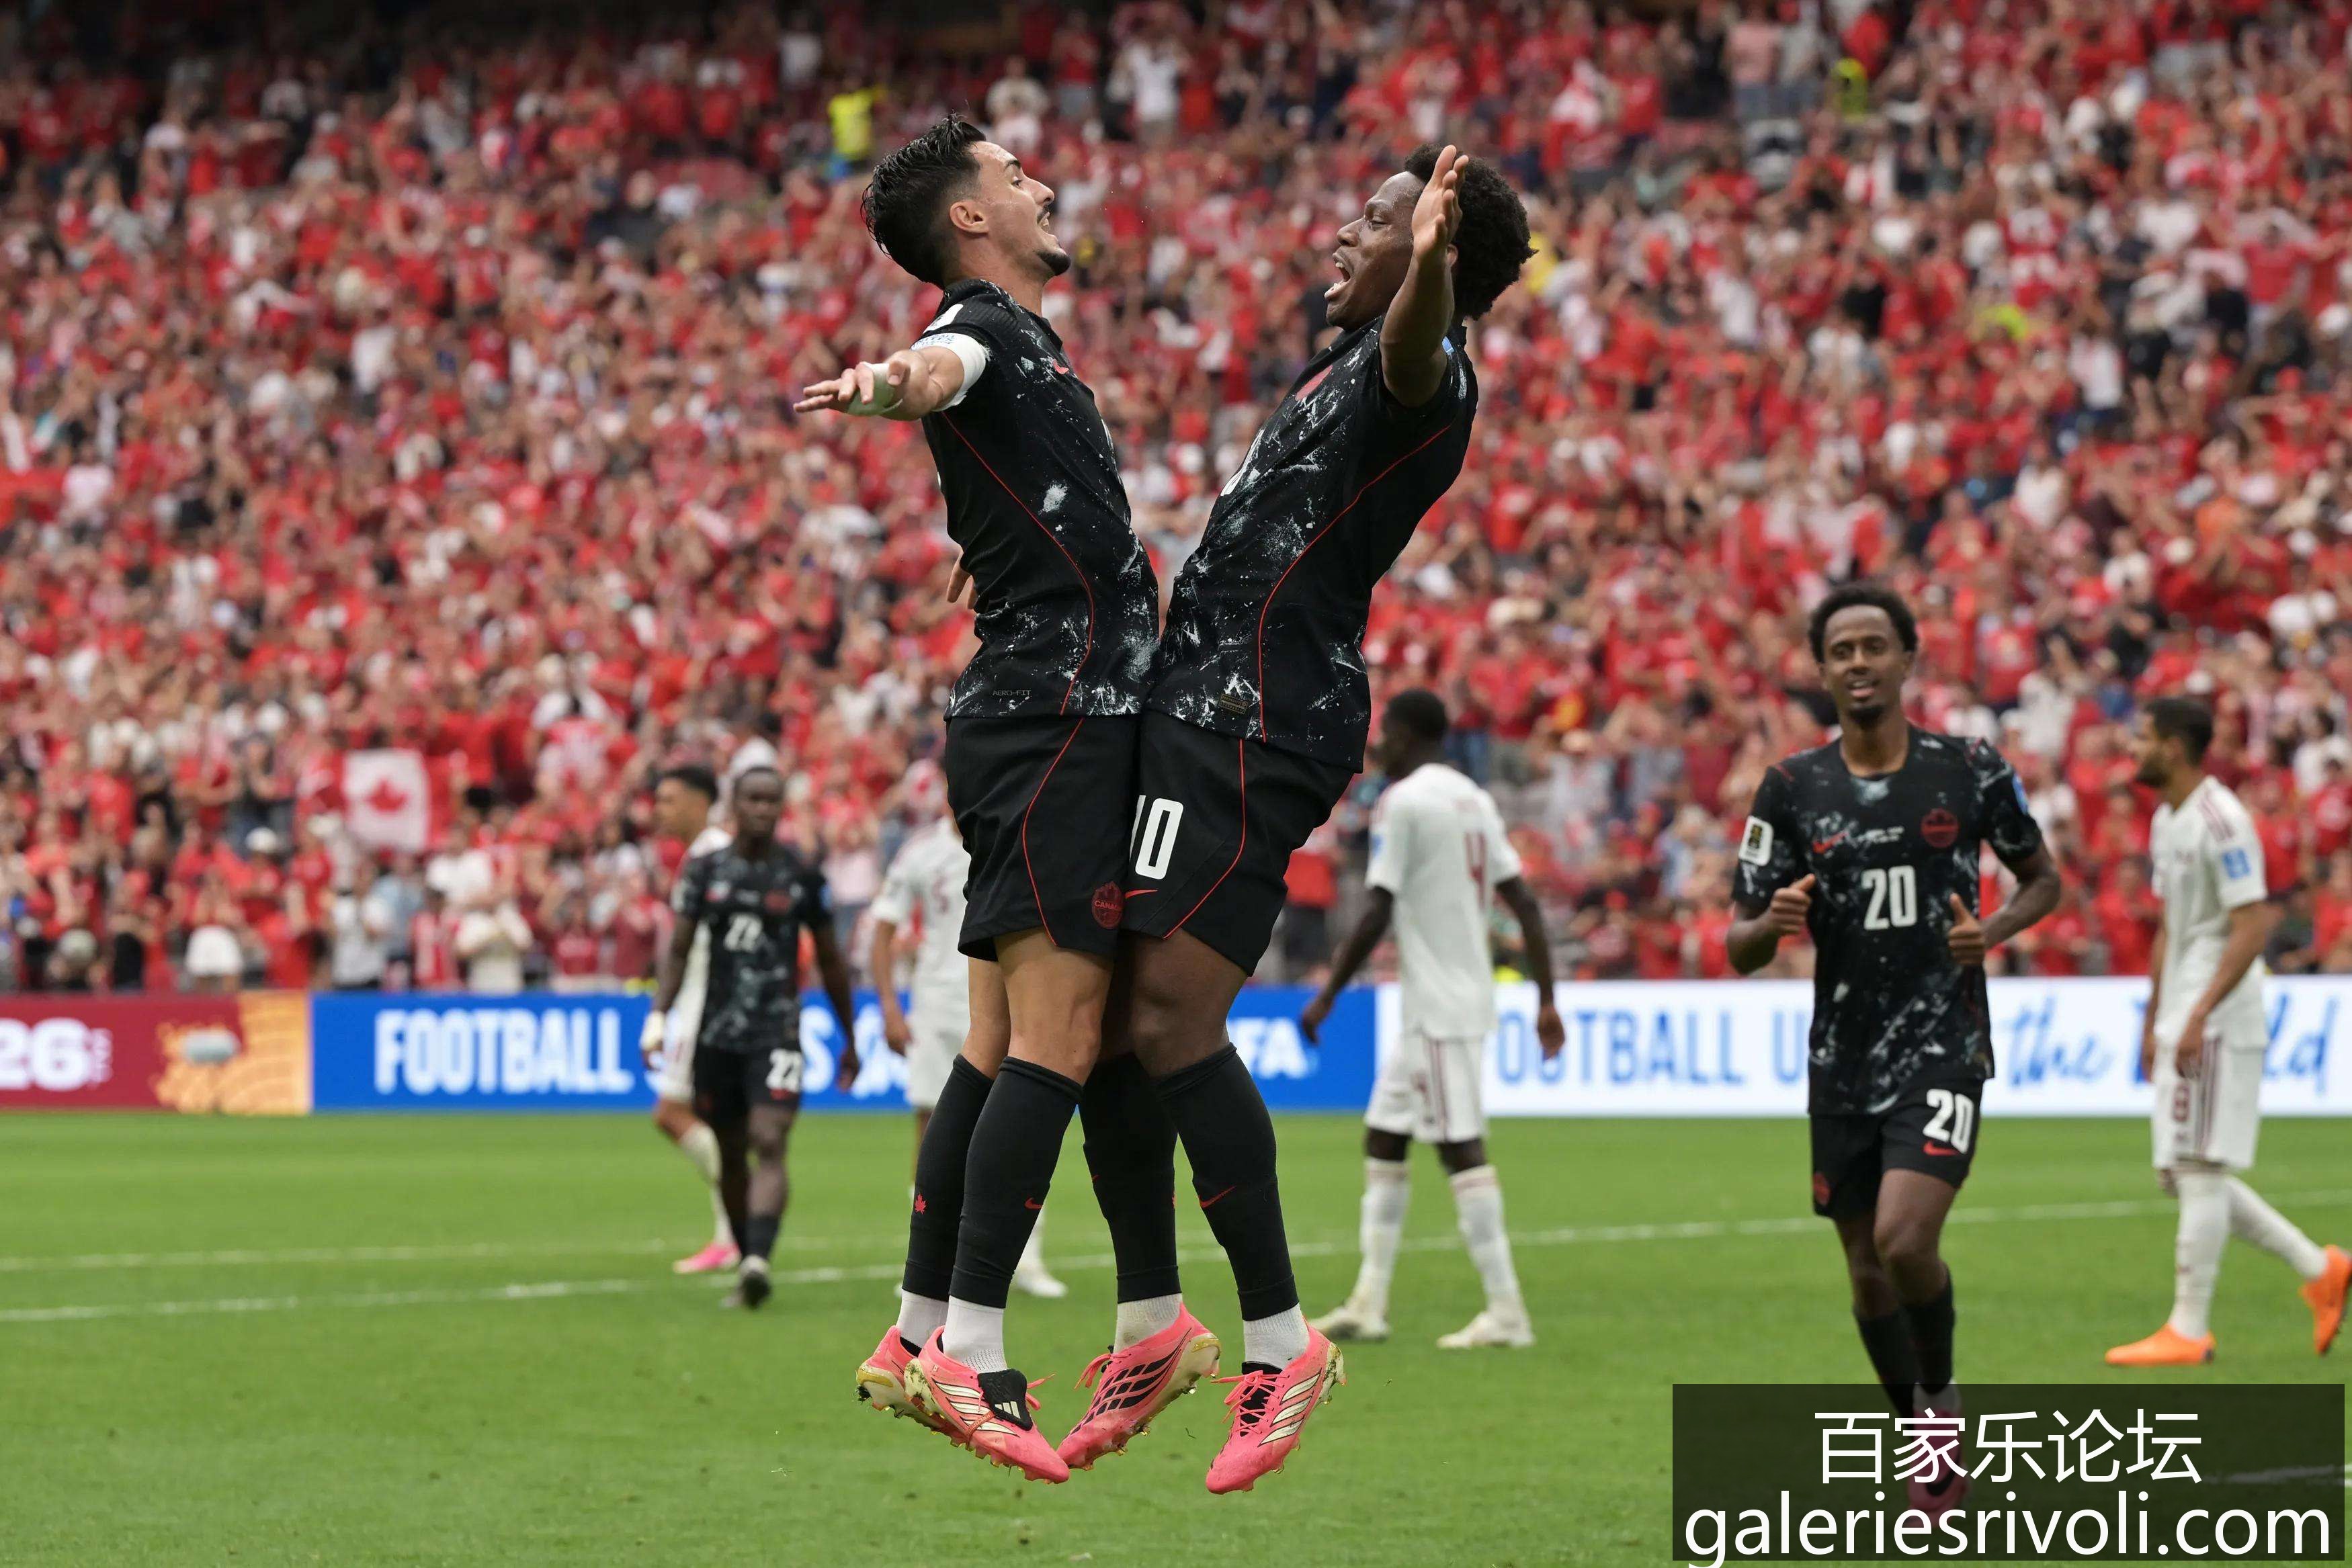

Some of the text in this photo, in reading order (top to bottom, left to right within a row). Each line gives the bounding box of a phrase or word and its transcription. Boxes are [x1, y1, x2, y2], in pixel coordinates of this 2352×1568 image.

[1861, 865, 1918, 931] 20
[724, 912, 763, 953] 22
[374, 1008, 636, 1094] FOOTBALL
[765, 1048, 802, 1092] 22
[1923, 1088, 1974, 1153] 20
